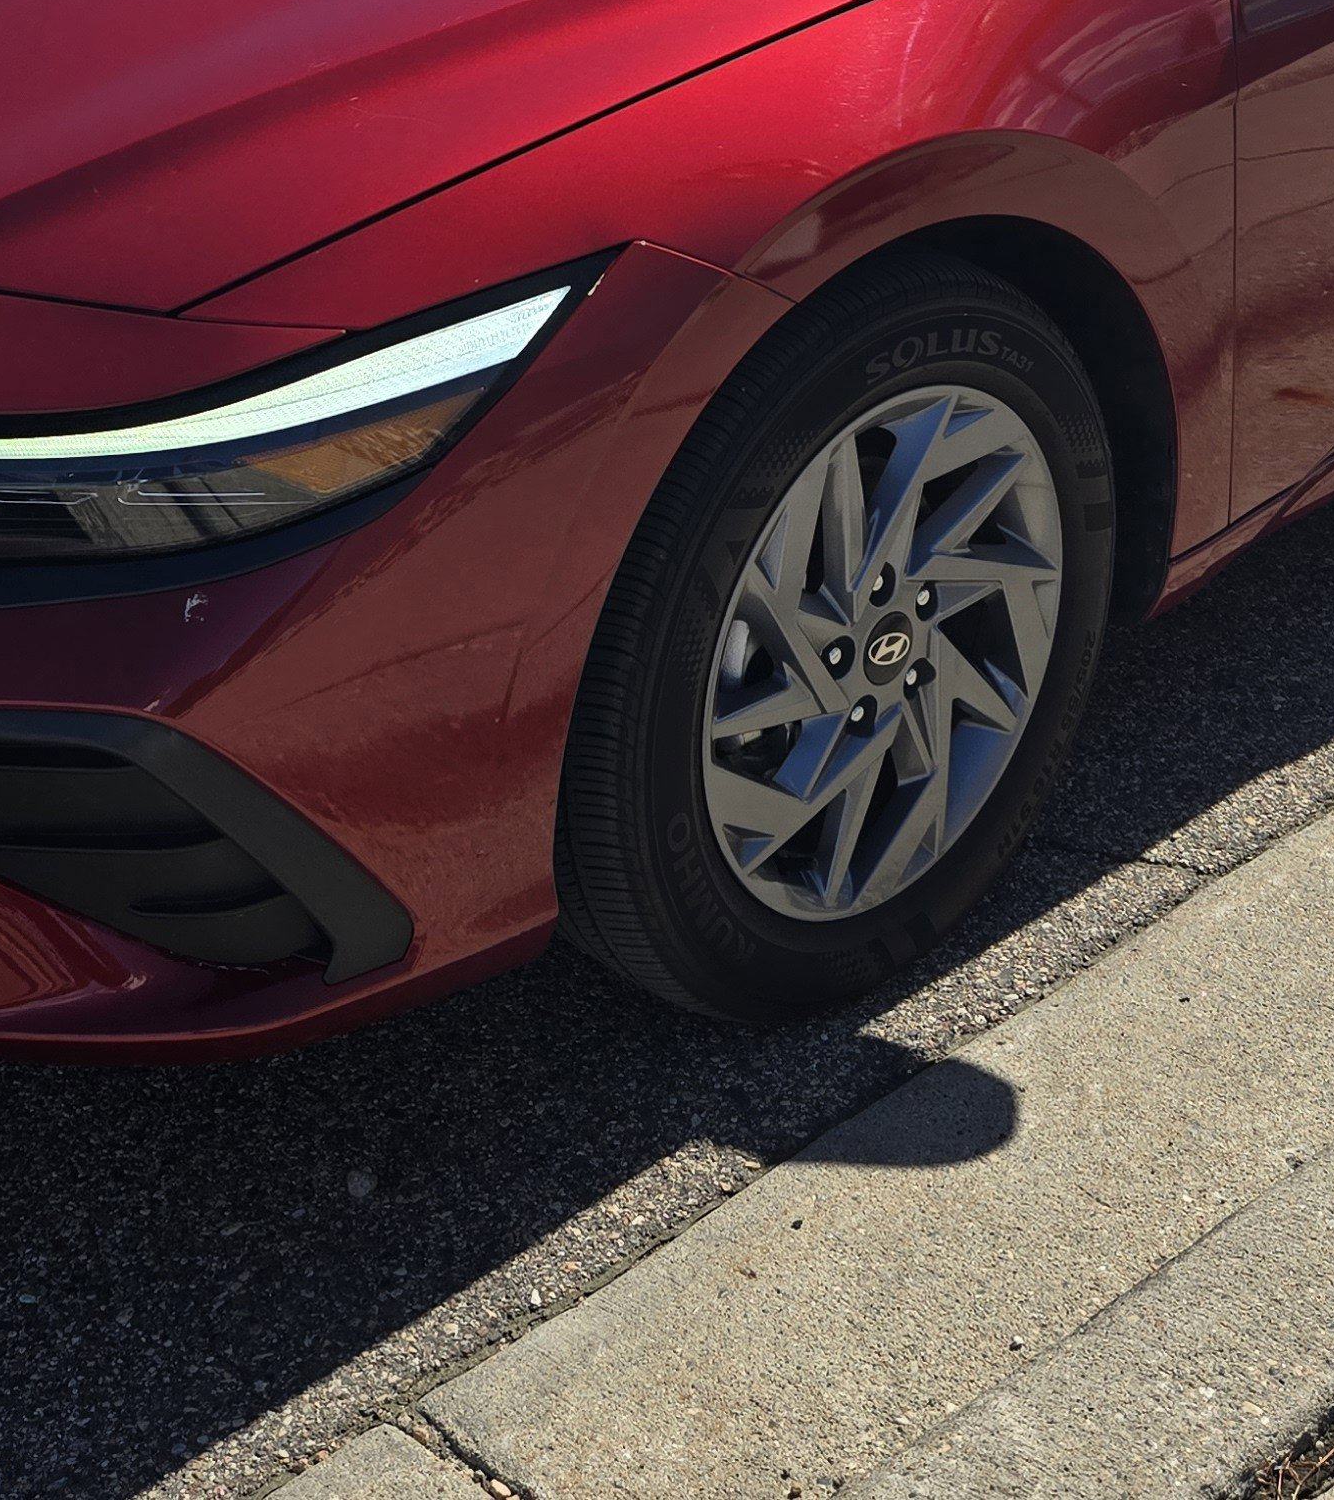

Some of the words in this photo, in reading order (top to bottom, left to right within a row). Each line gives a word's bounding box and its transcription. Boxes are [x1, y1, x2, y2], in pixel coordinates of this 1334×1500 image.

[865, 328, 1002, 385] SOLUS
[1000, 346, 1035, 373] TA31
[667, 811, 758, 965] KUMHO
